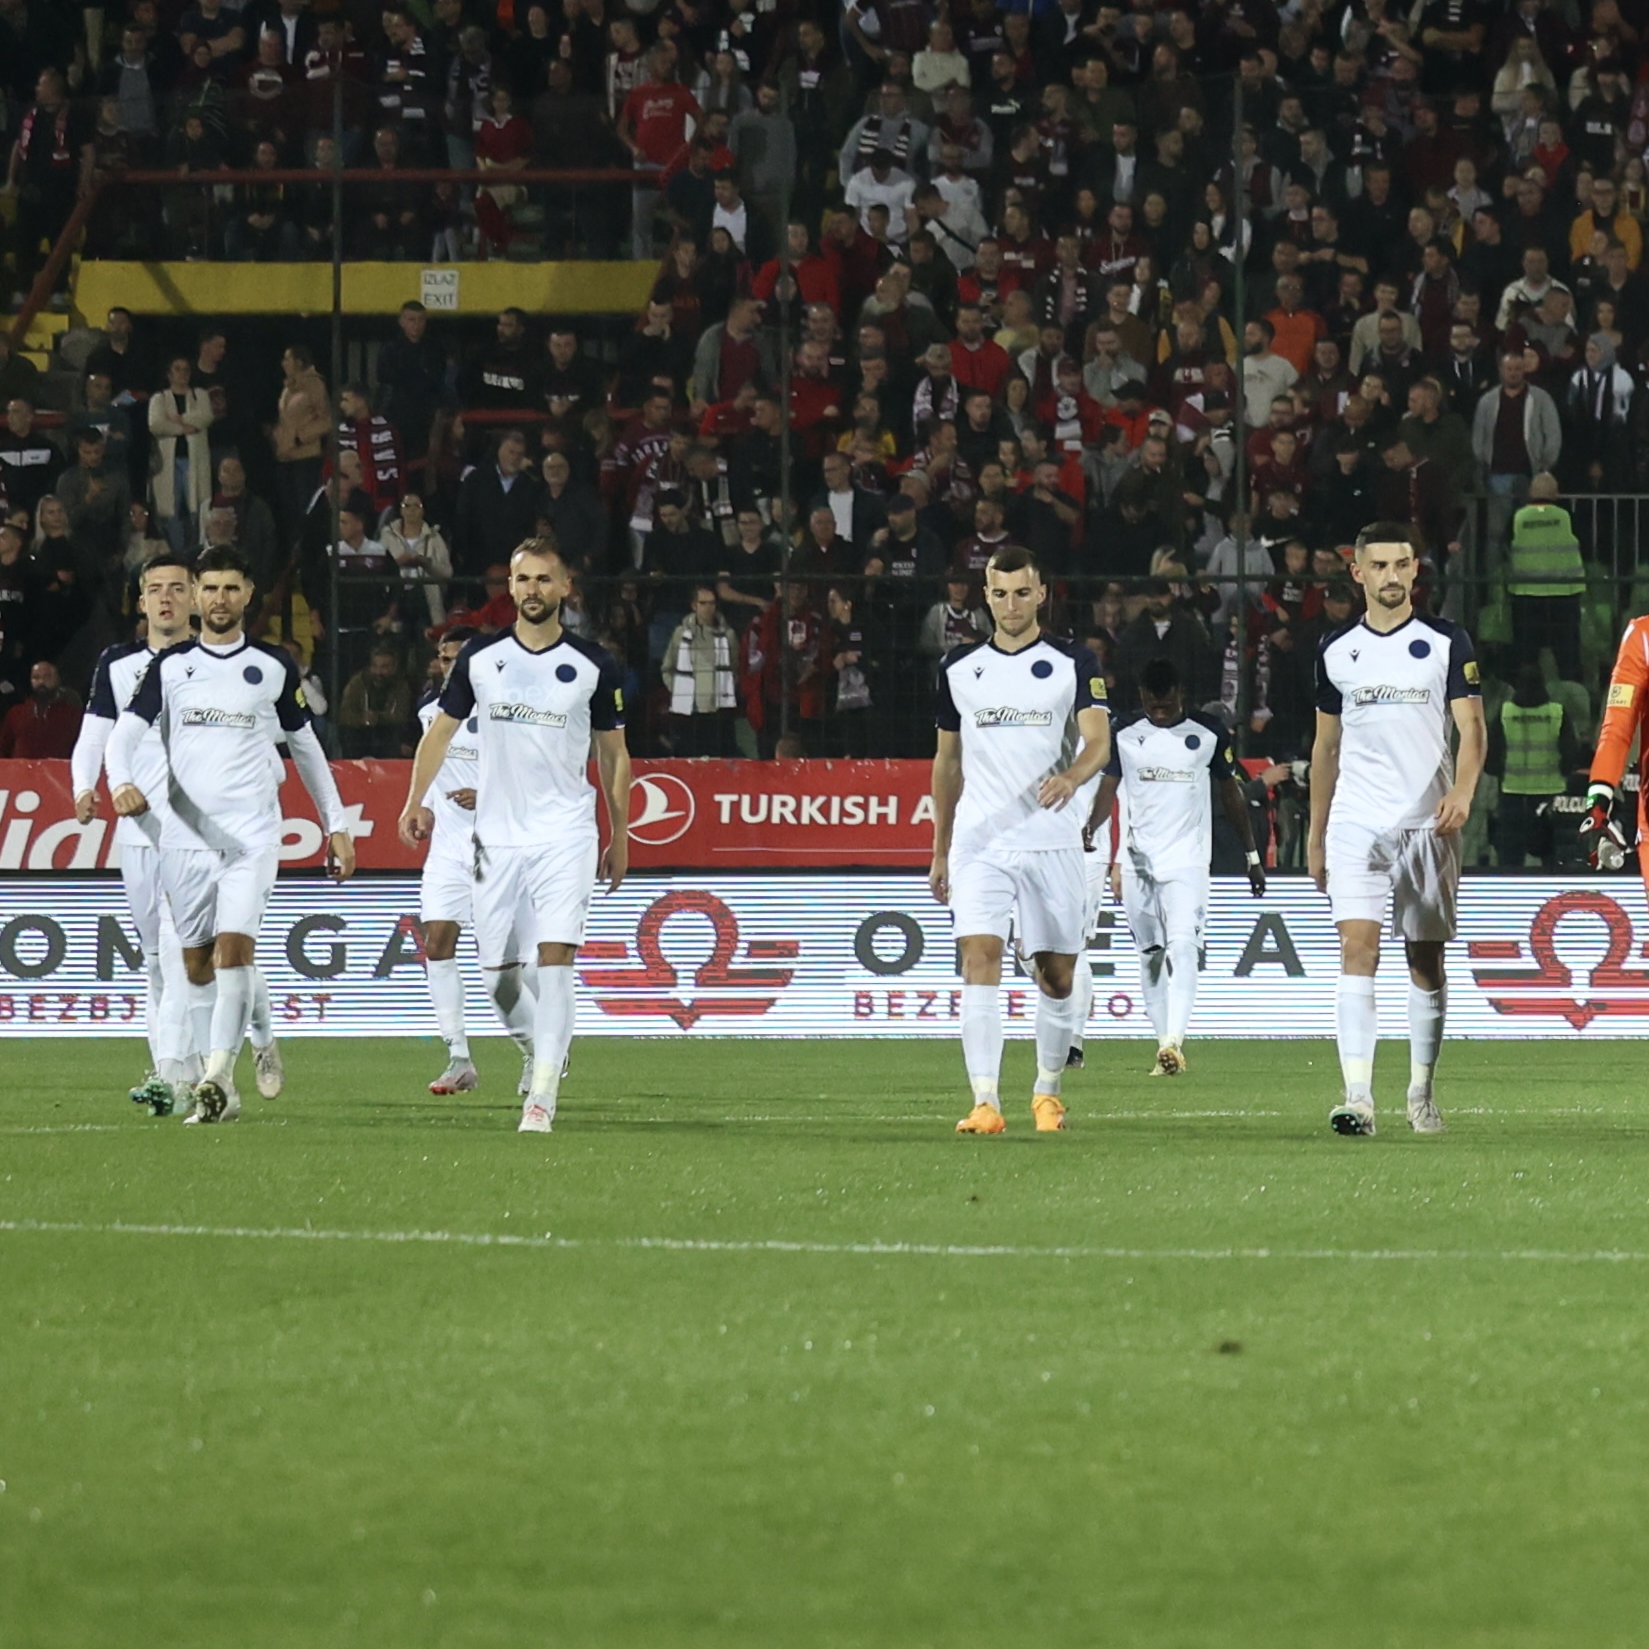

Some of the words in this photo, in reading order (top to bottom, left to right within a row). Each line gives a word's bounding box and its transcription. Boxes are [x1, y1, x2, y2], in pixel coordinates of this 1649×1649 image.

[424, 293, 454, 306] EXIT
[1352, 687, 1373, 702] The
[489, 703, 510, 718] The
[974, 708, 997, 724] The
[713, 793, 898, 826] TURKISH
